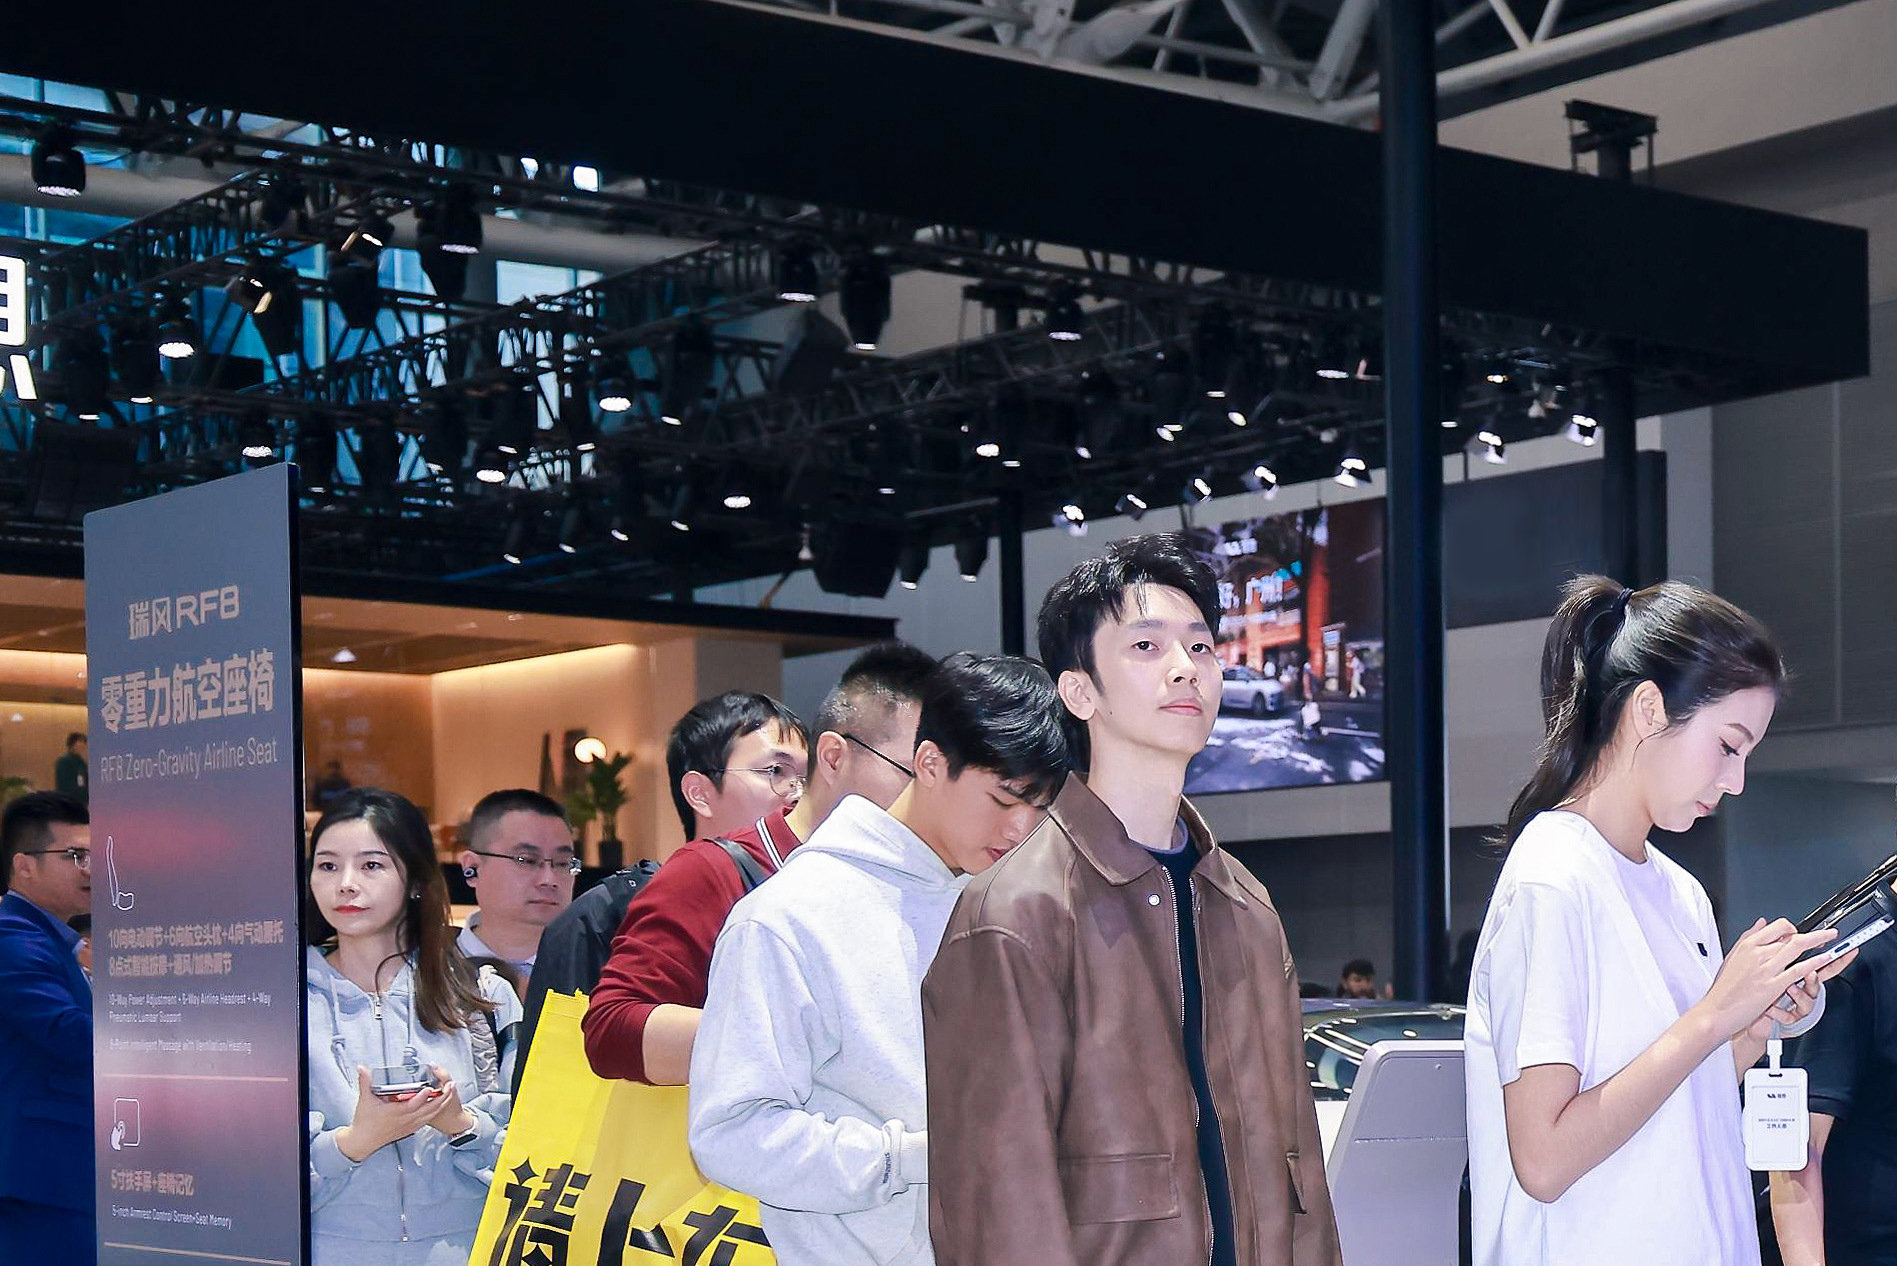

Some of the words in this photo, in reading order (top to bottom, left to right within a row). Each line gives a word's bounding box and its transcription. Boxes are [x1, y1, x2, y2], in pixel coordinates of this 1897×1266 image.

[100, 648, 274, 734] 零重力航空座椅
[101, 754, 123, 783] RF8
[126, 747, 200, 781] Zero-Gravity
[204, 741, 244, 771] Airline
[247, 737, 278, 766] Seat
